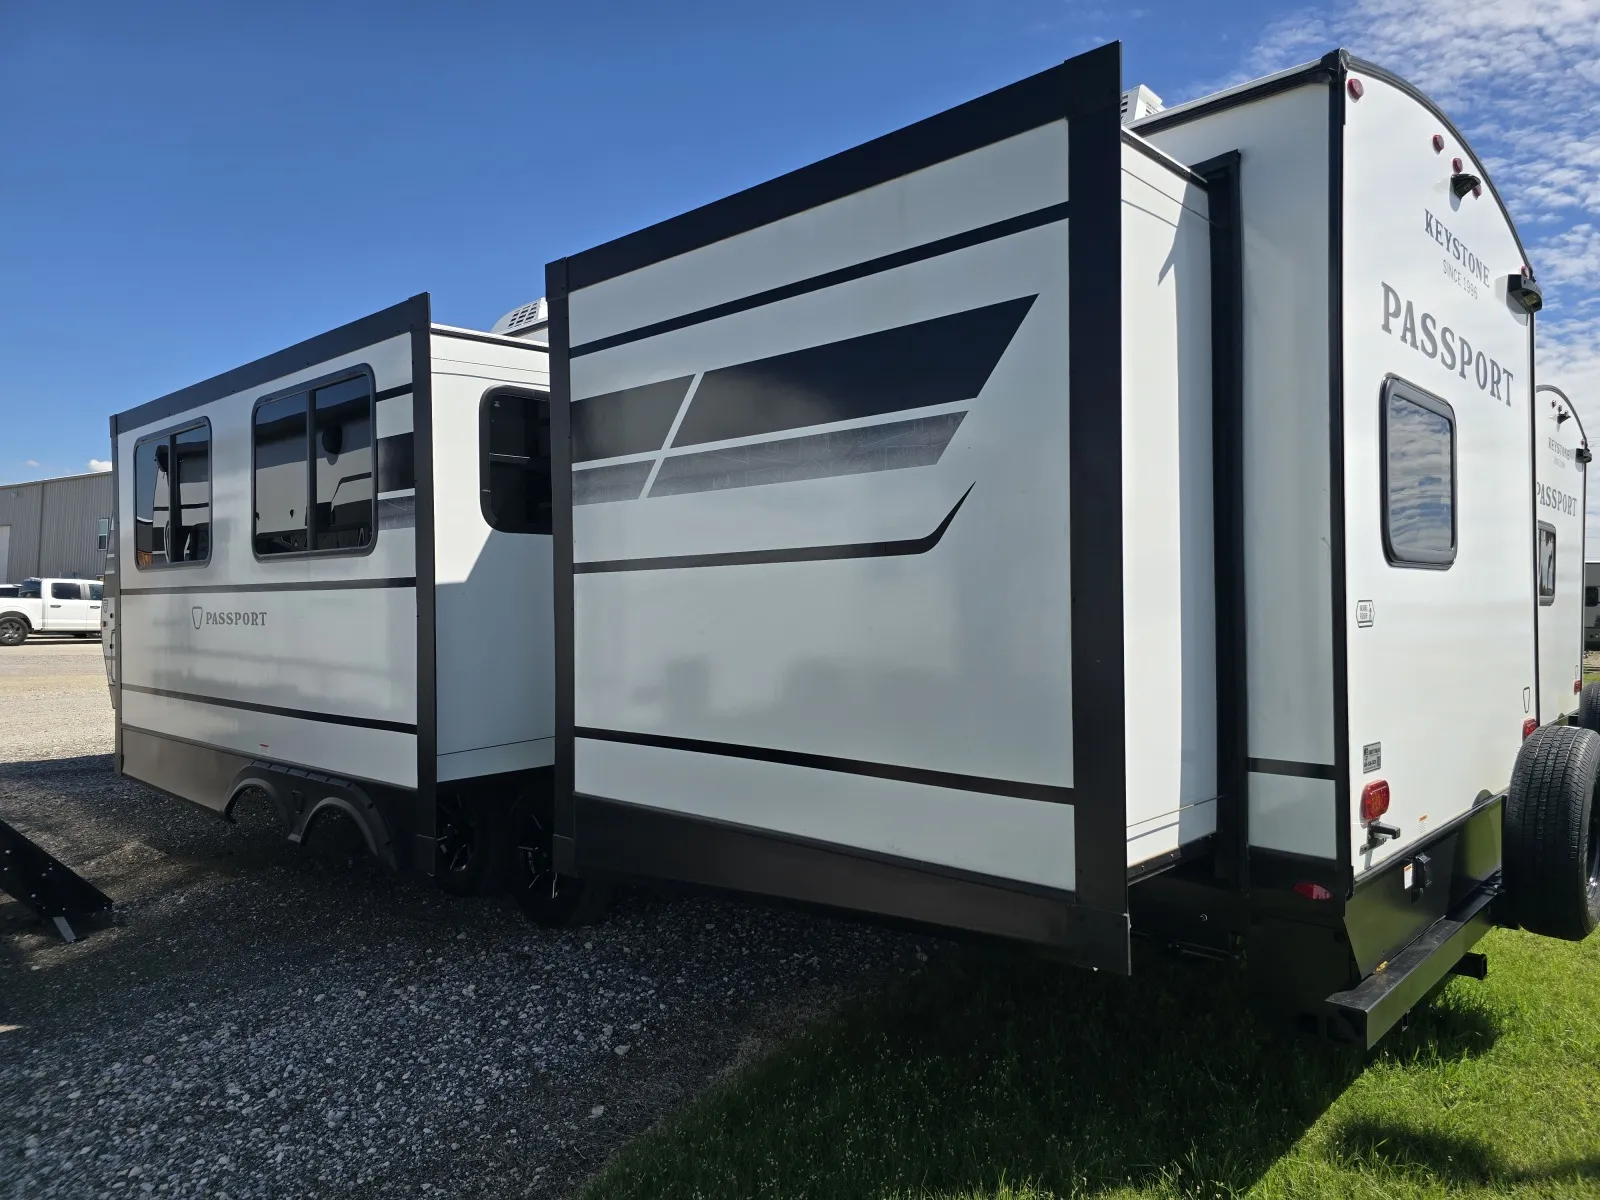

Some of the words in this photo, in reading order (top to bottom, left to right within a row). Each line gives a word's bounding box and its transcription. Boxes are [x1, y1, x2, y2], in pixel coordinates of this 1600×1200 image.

[1424, 208, 1490, 288] KEYSTONE
[1443, 259, 1462, 287] SINCE
[1381, 281, 1514, 407] PASSPORT
[206, 612, 267, 626] PASSPORT
